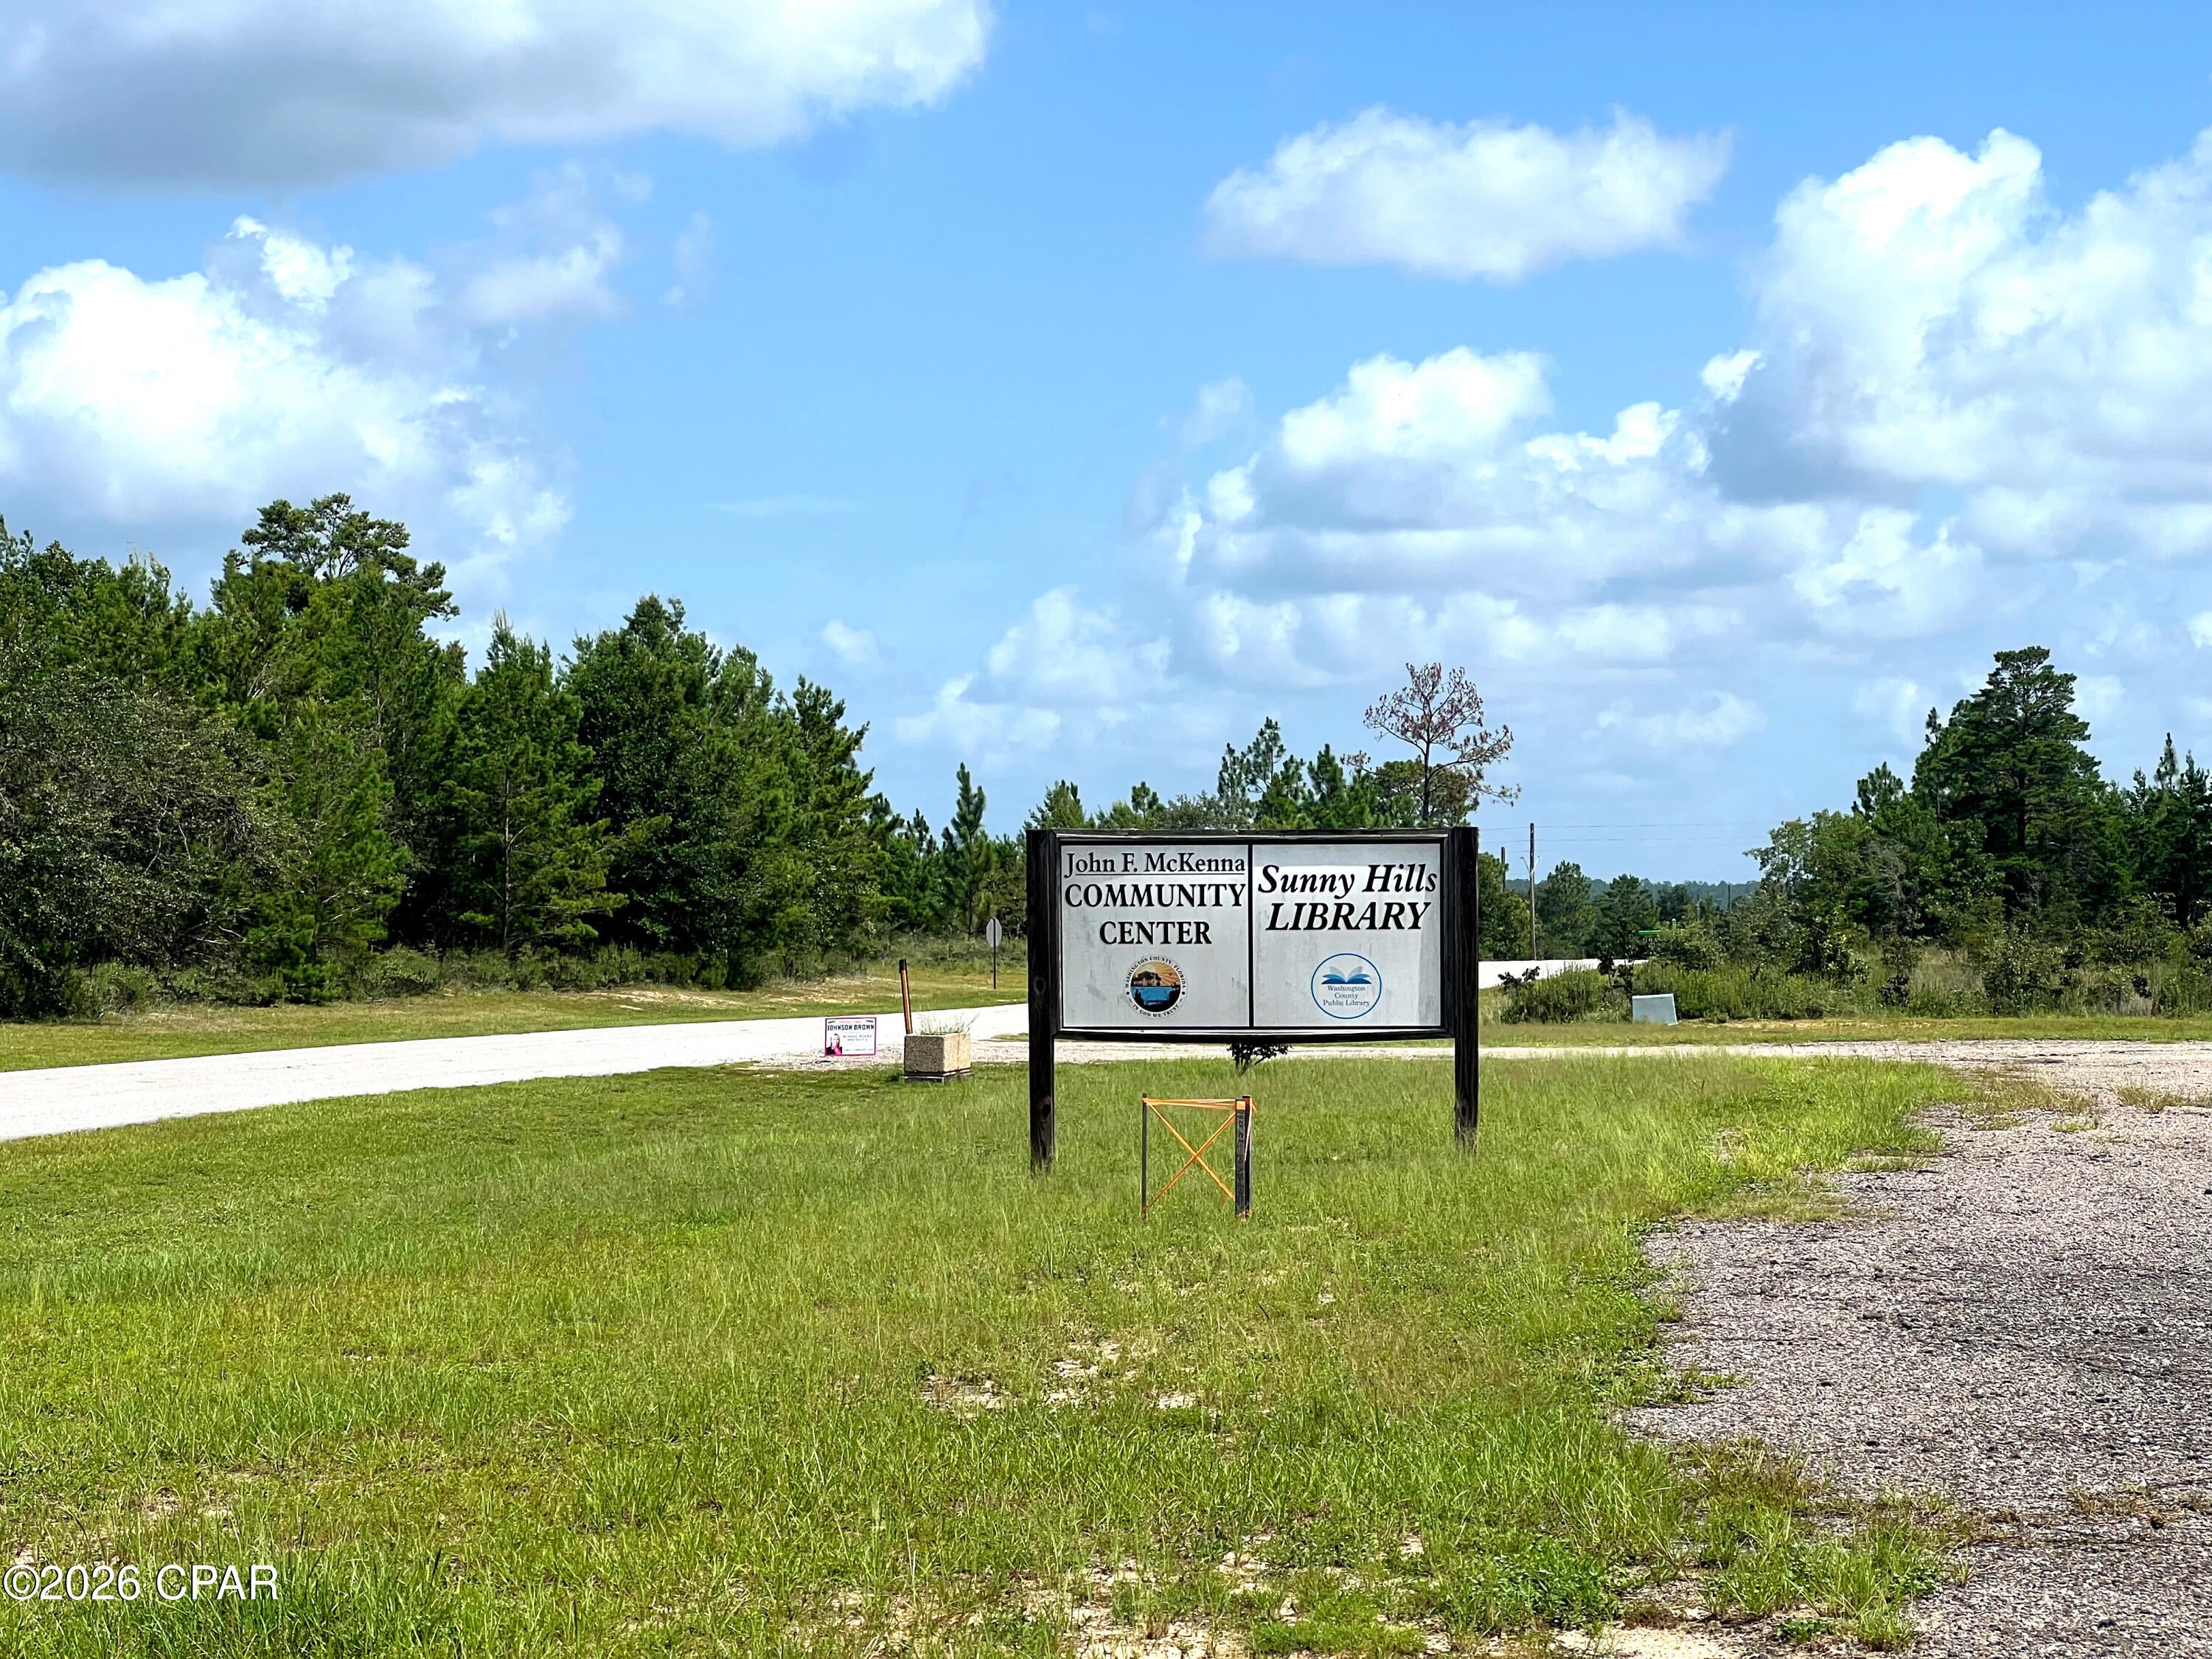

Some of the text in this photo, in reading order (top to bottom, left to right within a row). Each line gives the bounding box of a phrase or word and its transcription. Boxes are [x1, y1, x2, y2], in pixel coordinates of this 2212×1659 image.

[1064, 852, 1246, 878] John F. McKenna
[1257, 863, 1438, 900] Sunny Hills
[1065, 883, 1246, 908] COMMUNITY
[1265, 901, 1432, 931] LIBRARY
[1099, 921, 1212, 945] CENTER
[1125, 958, 1149, 988] WASHINGTON
[1173, 964, 1186, 989] FLORIDA
[1139, 1009, 1151, 1018] GOD
[1163, 1004, 1180, 1017] TRUST
